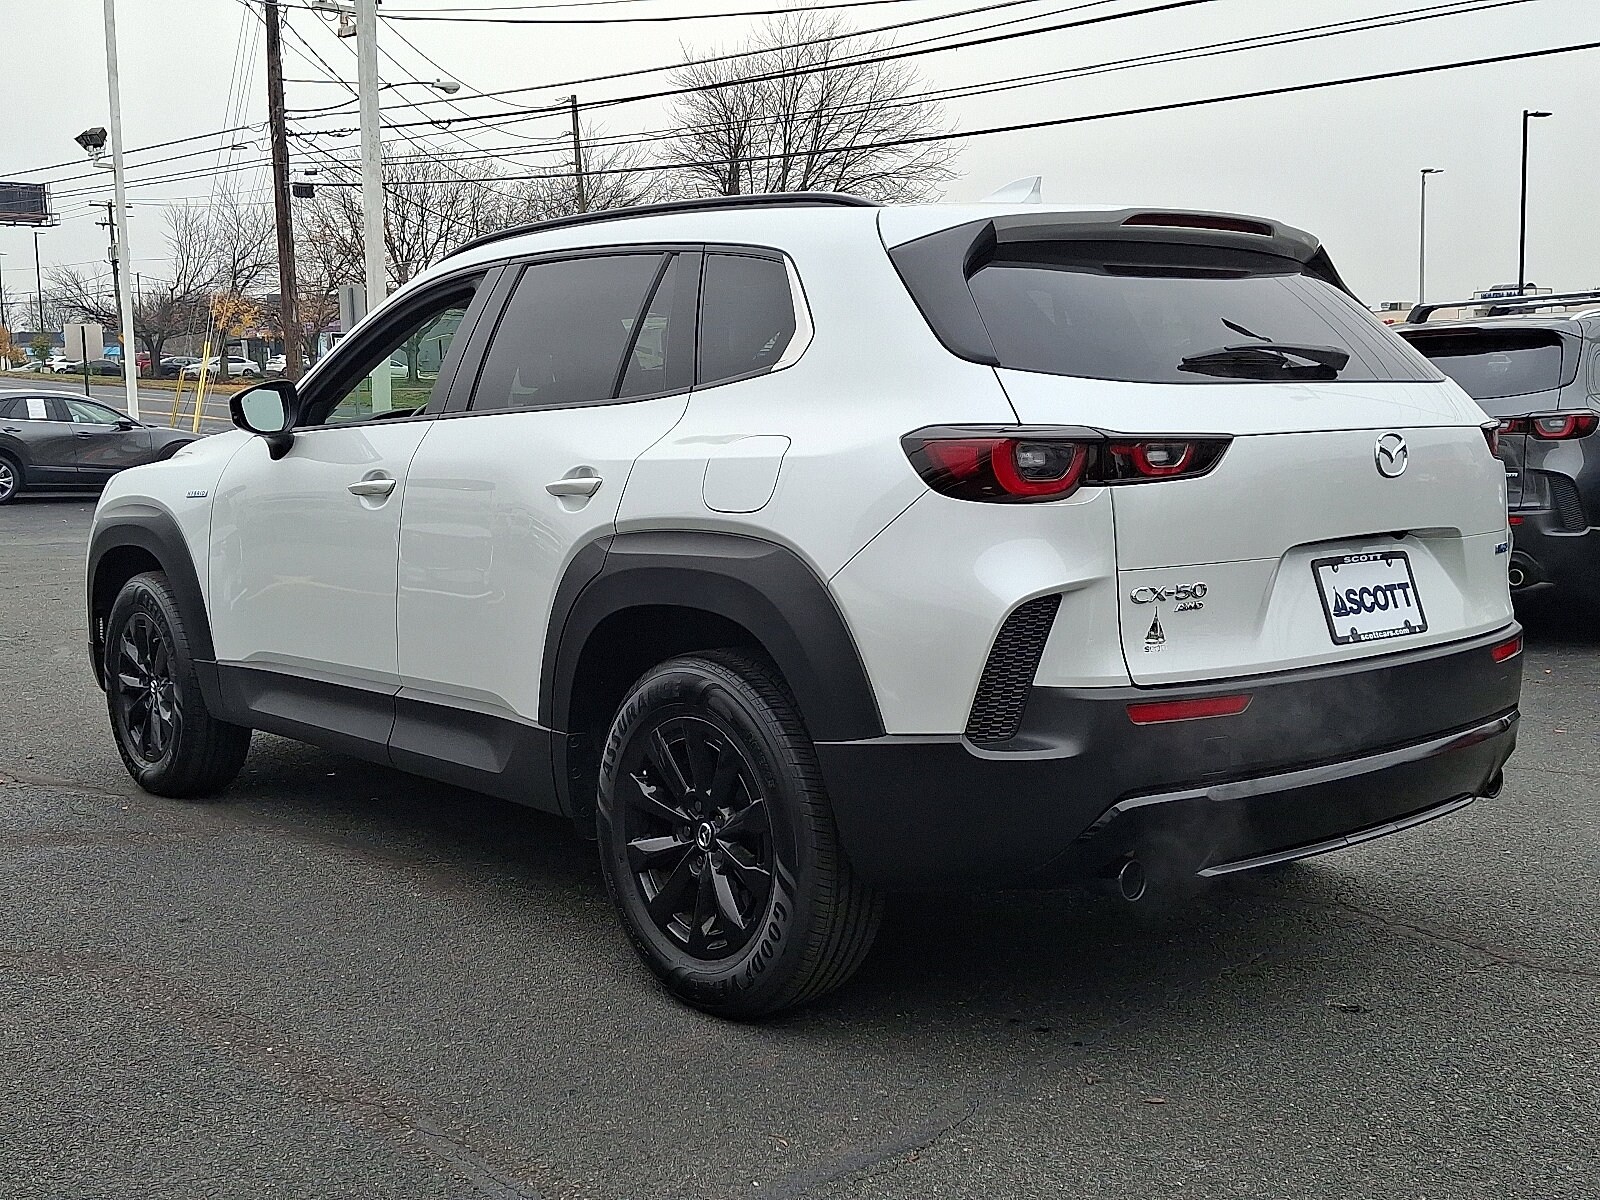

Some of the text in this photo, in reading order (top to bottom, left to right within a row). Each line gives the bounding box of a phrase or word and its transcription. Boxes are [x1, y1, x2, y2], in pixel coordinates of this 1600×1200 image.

[1344, 554, 1383, 564] SCOTT
[1130, 582, 1208, 604] CX-50
[1345, 582, 1412, 615] SCOTT
[1174, 601, 1204, 613] AWD
[1360, 628, 1410, 641] scottcars.com
